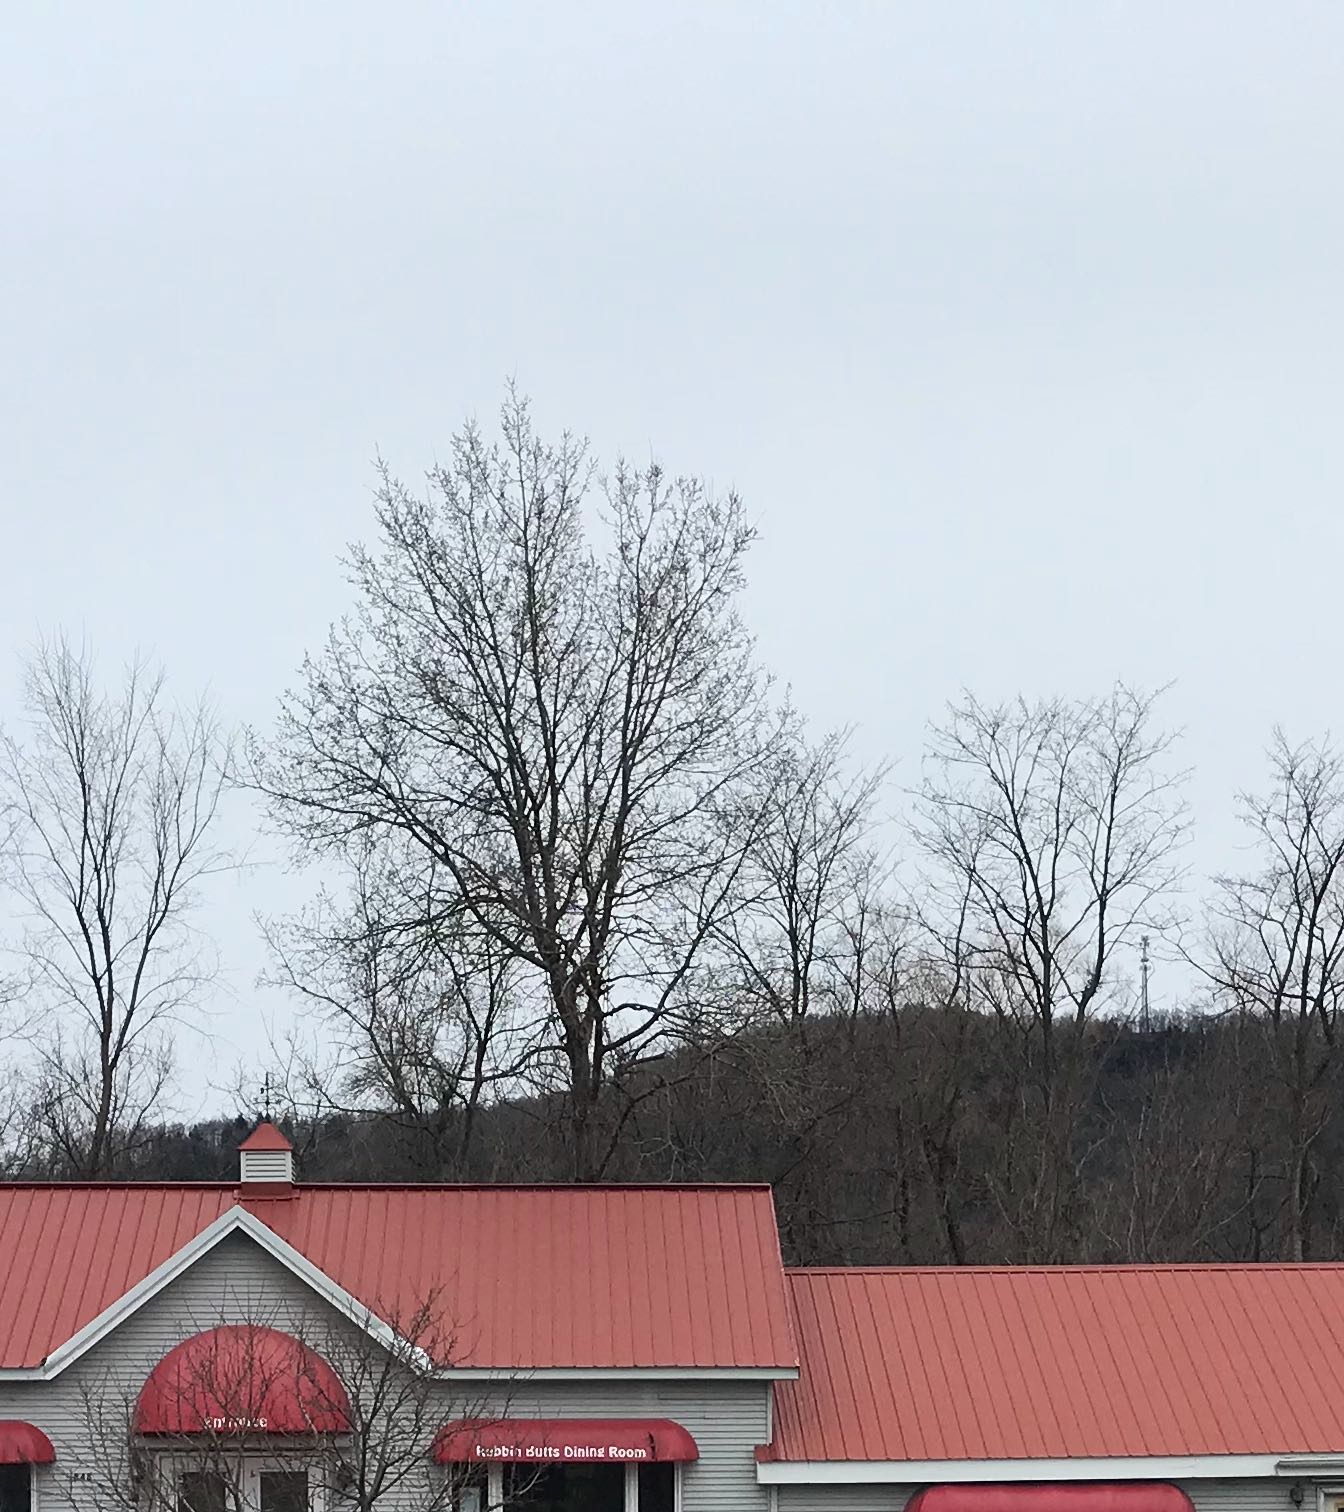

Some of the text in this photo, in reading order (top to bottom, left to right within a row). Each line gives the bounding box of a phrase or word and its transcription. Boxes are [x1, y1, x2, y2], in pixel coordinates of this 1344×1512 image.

[525, 1445, 560, 1458] Butts
[564, 1445, 605, 1458] Dining
[608, 1446, 647, 1458] Room
